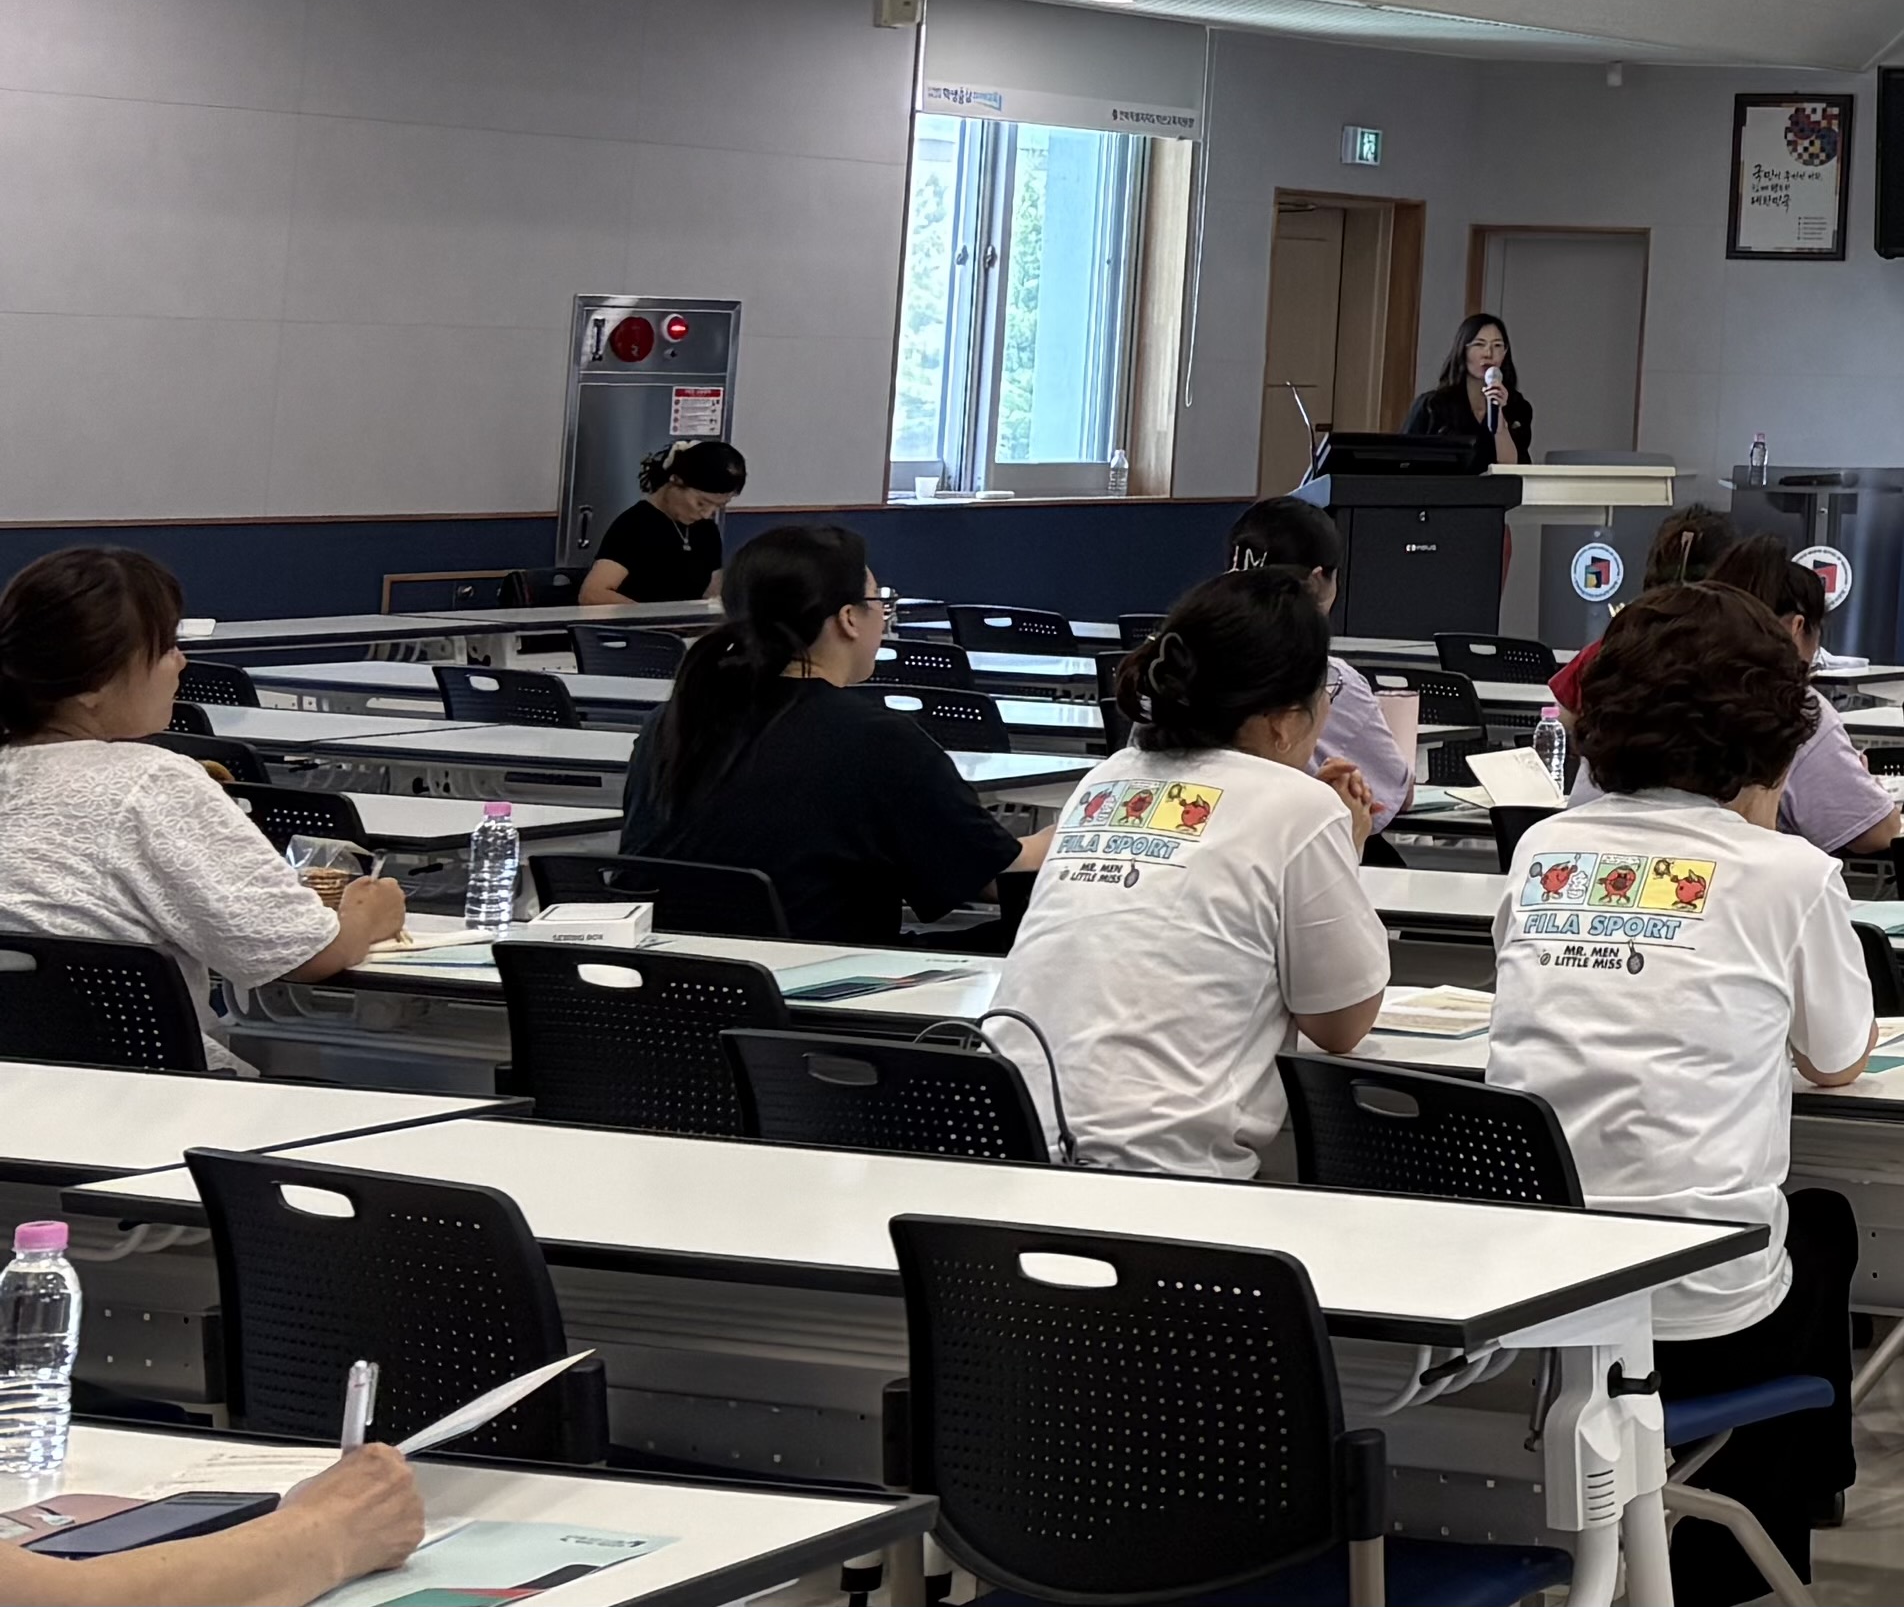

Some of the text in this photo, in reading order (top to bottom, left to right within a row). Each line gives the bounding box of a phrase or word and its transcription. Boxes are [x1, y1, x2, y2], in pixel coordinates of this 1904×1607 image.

[1057, 834, 1181, 860] FILA SPORT
[1070, 872, 1122, 884] LITTLE MISS
[1523, 913, 1682, 940] FILA SPORT
[1563, 945, 1620, 958] MR. MEN
[1554, 955, 1622, 970] LITTLE MISS
